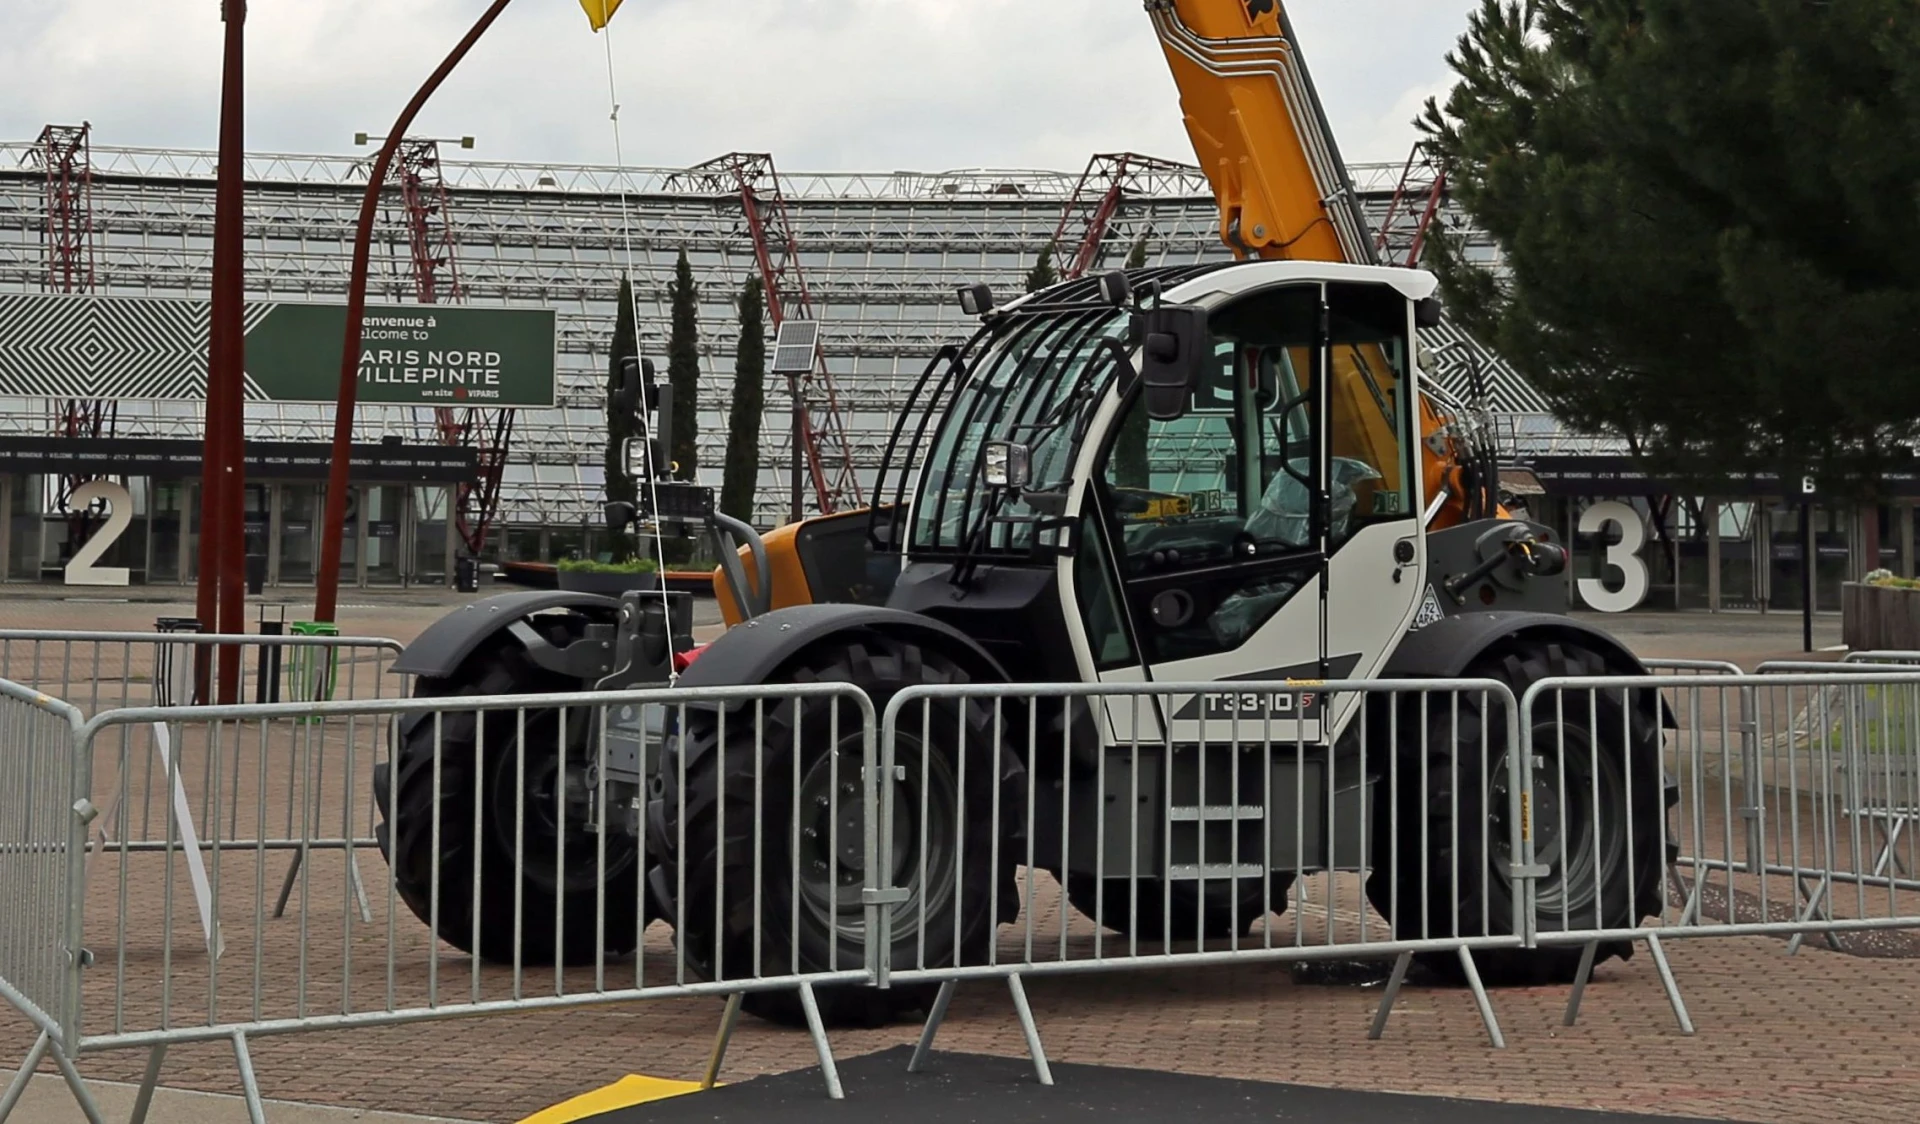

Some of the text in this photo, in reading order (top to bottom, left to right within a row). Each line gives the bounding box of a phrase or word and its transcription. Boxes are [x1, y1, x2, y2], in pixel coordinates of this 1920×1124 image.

[361, 315, 437, 328] envenue à
[360, 328, 429, 341] elcome to
[359, 349, 501, 367] ARIS NORD
[421, 388, 500, 398] un site VIPARIS
[64, 480, 133, 586] 2
[1578, 500, 1648, 612] 3
[1424, 602, 1435, 613] 92
